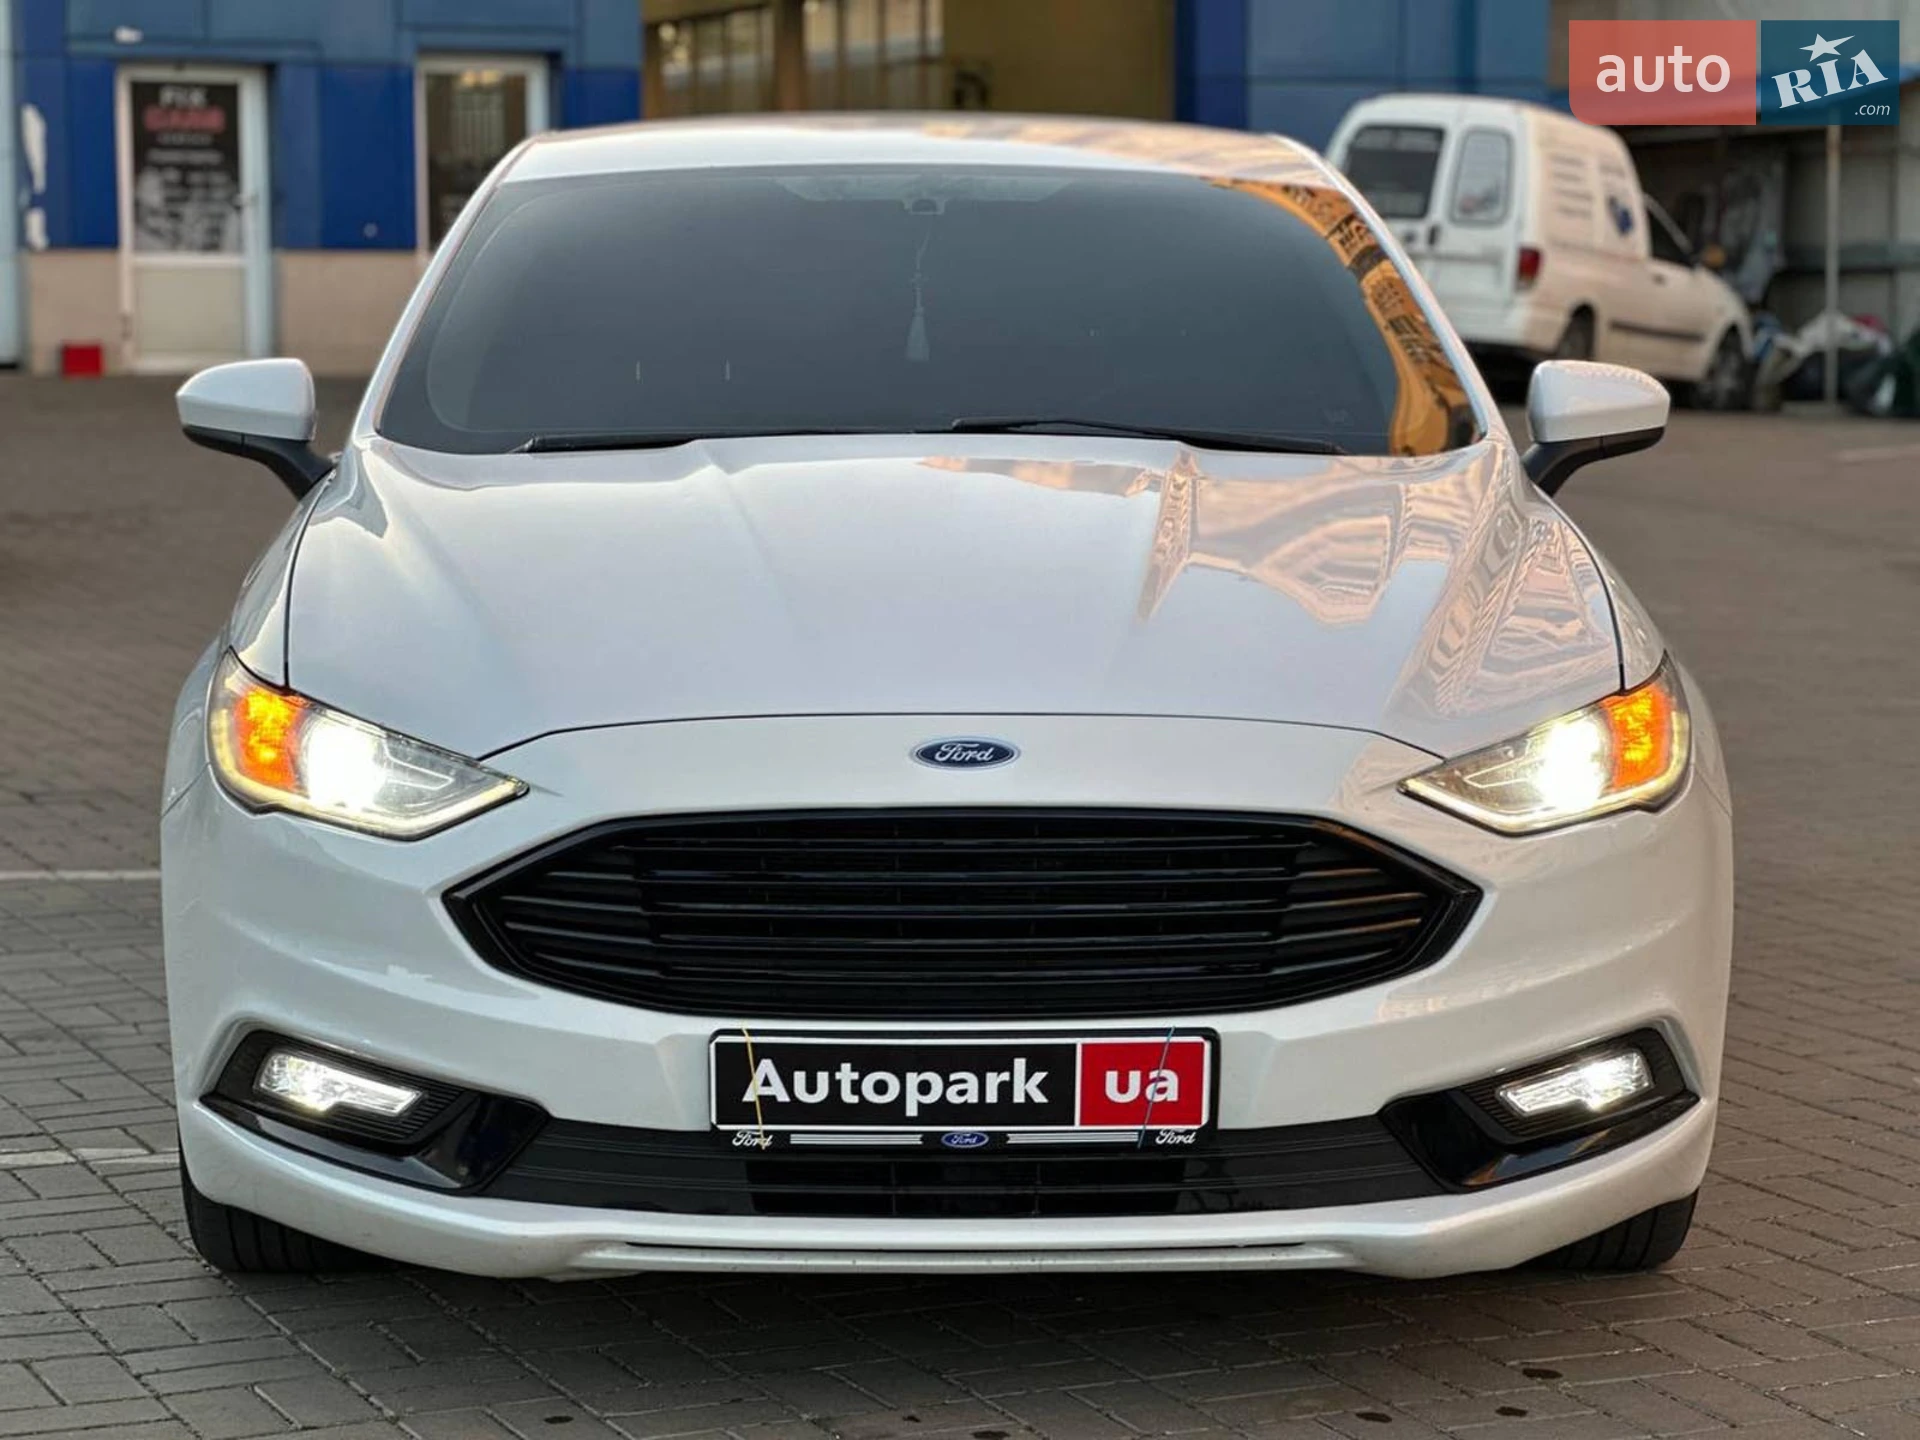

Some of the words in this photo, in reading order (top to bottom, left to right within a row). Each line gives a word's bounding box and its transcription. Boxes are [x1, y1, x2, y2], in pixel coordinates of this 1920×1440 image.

[934, 742, 995, 761] Ford
[742, 1058, 1049, 1117] Autopark
[1105, 1069, 1179, 1102] ua
[732, 1128, 773, 1148] Ford
[950, 1133, 979, 1146] Ford
[1155, 1127, 1196, 1146] Ford
